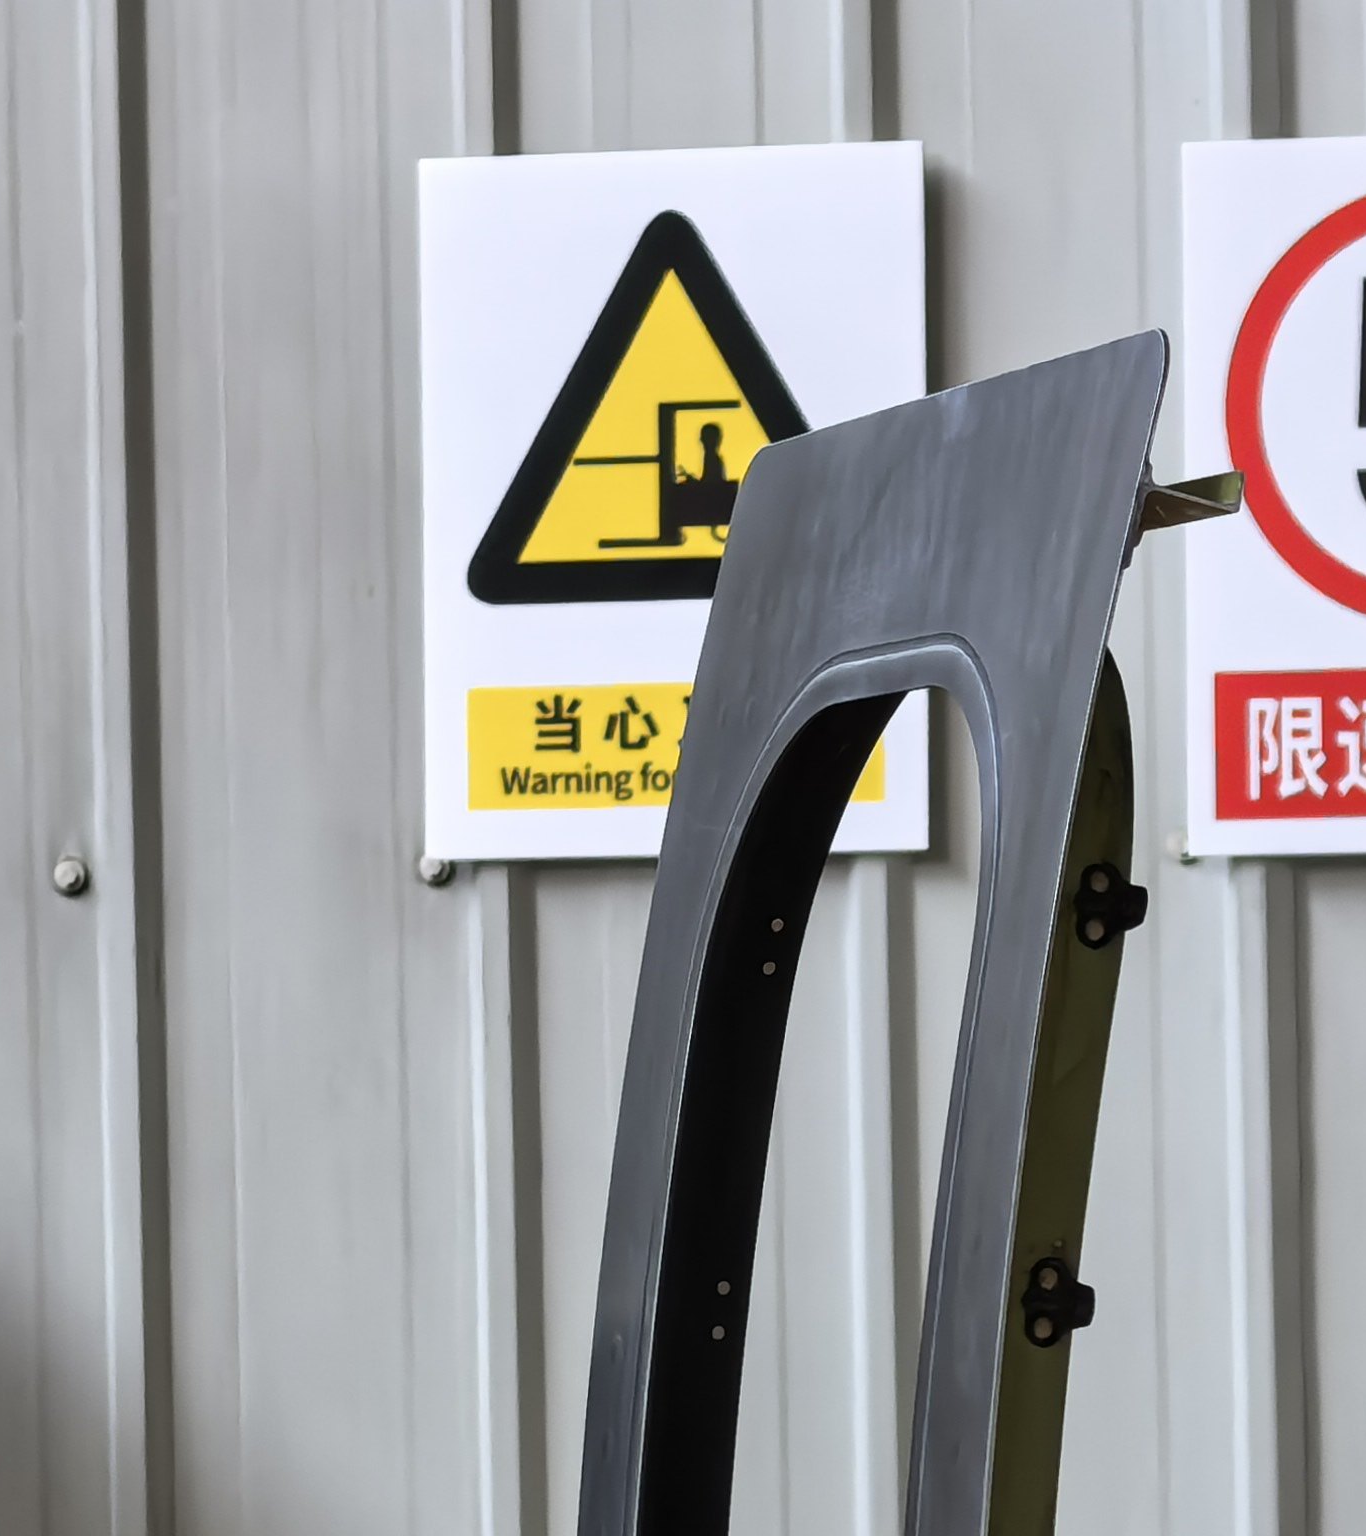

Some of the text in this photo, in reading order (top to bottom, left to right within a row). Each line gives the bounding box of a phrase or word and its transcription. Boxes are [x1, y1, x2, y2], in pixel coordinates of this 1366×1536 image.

[534, 694, 690, 753] 当心
[501, 761, 674, 800] Warning fo
